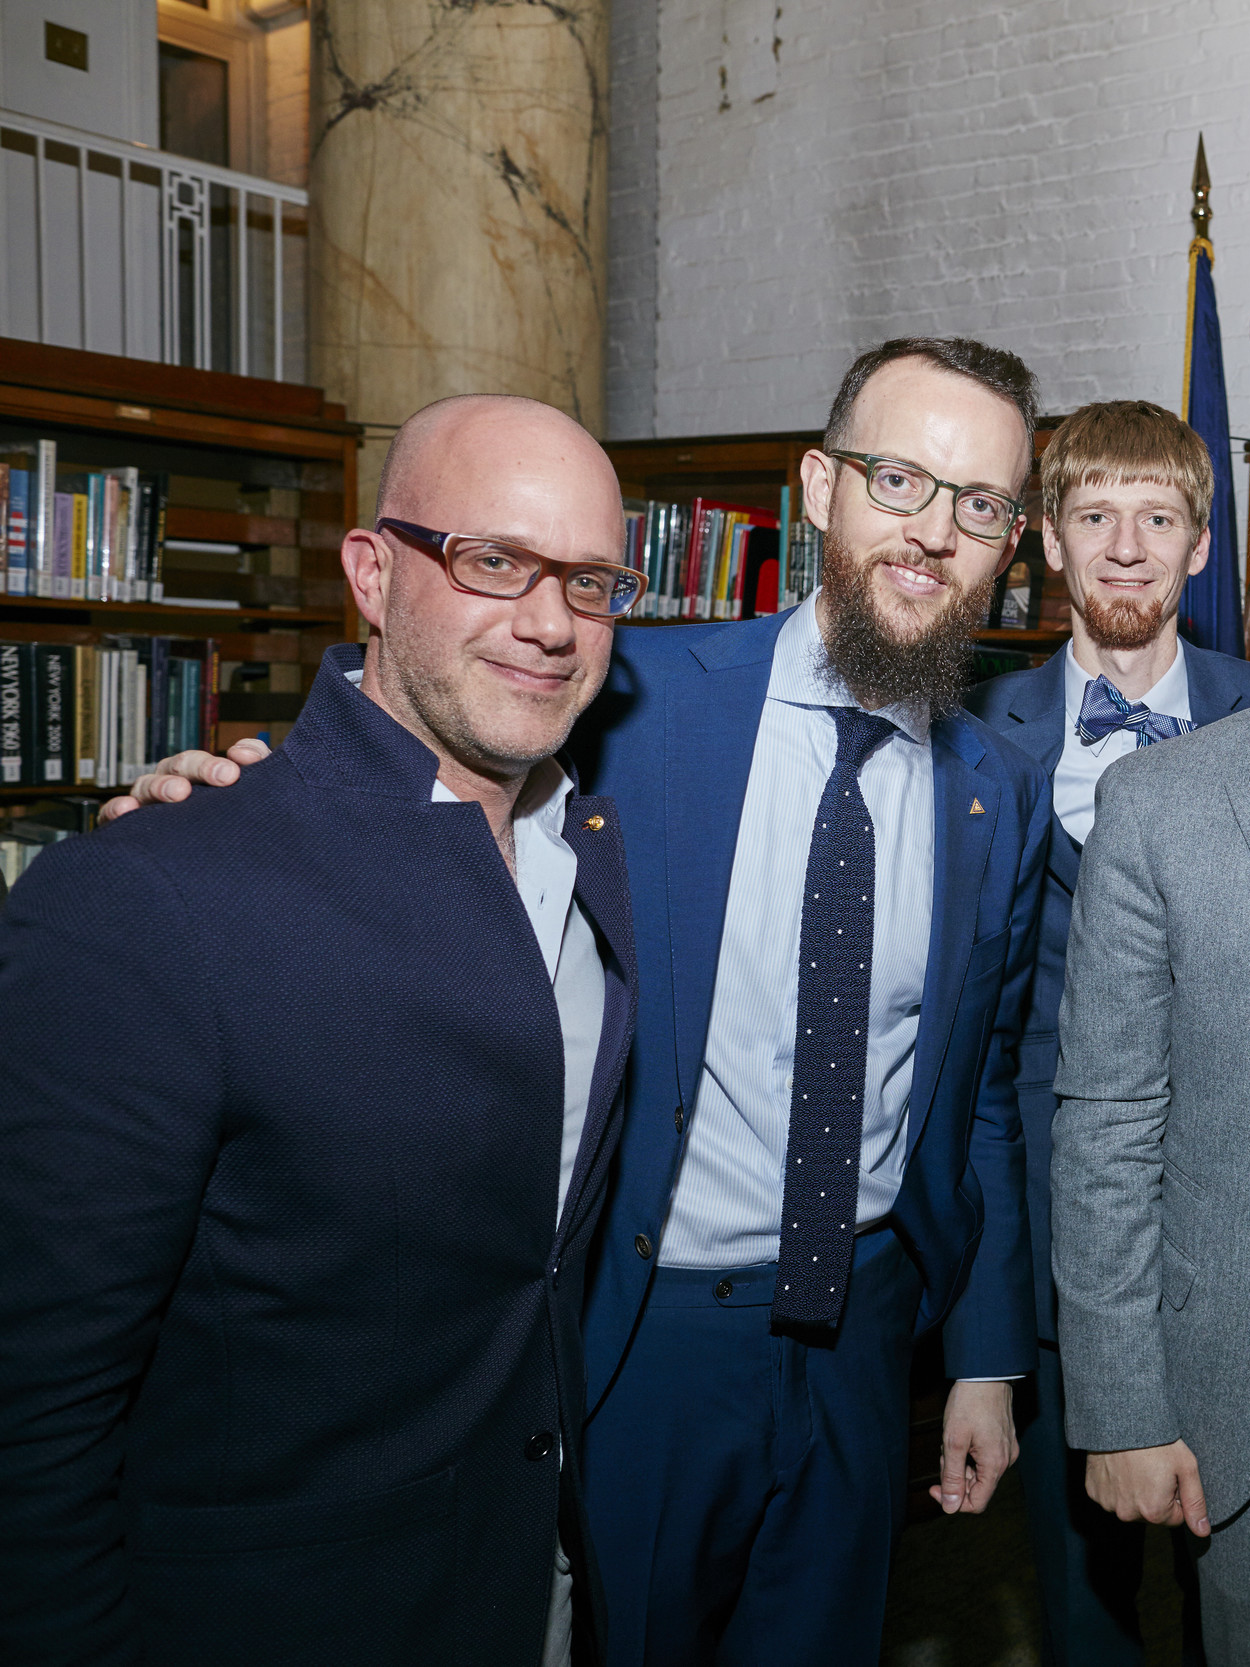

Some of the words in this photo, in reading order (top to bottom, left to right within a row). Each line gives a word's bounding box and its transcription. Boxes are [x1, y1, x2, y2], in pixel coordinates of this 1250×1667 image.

[1, 646, 20, 681] NEW
[48, 655, 62, 686] NEW
[2, 681, 20, 720] YORK
[47, 687, 62, 721] YORK
[2, 722, 20, 750] 1960
[47, 725, 62, 752] 2000
